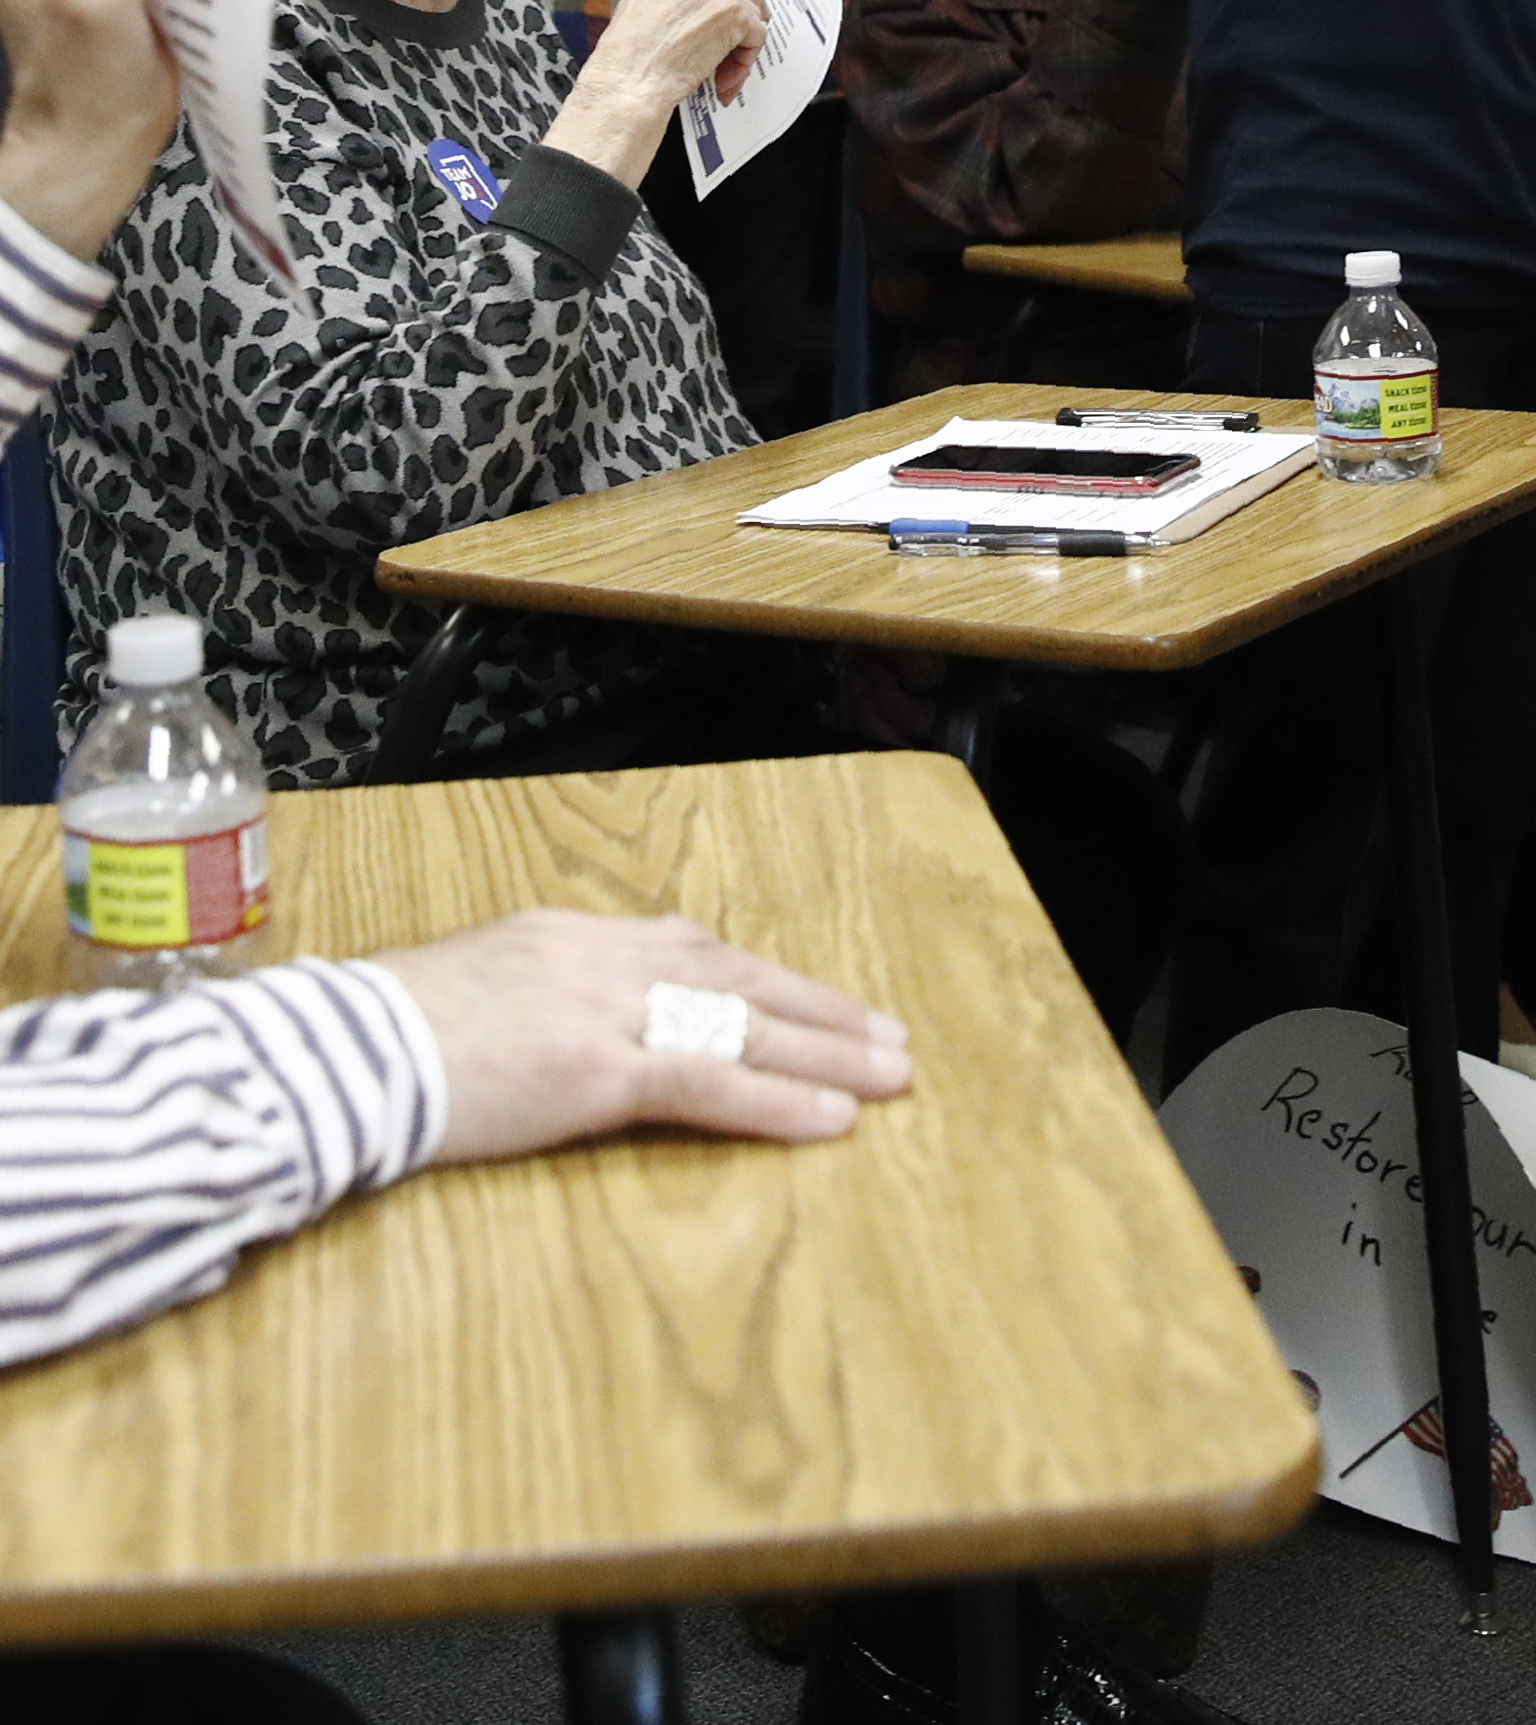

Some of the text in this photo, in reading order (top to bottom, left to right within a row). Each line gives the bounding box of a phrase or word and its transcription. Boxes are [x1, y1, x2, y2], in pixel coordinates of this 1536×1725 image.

[440, 166, 473, 182] TEAM
[1385, 388, 1409, 397] SNACK
[1388, 404, 1409, 413] MEAL
[1391, 419, 1407, 429] ANY
[1261, 1067, 1422, 1203] Restore
[1340, 1201, 1382, 1268] in
